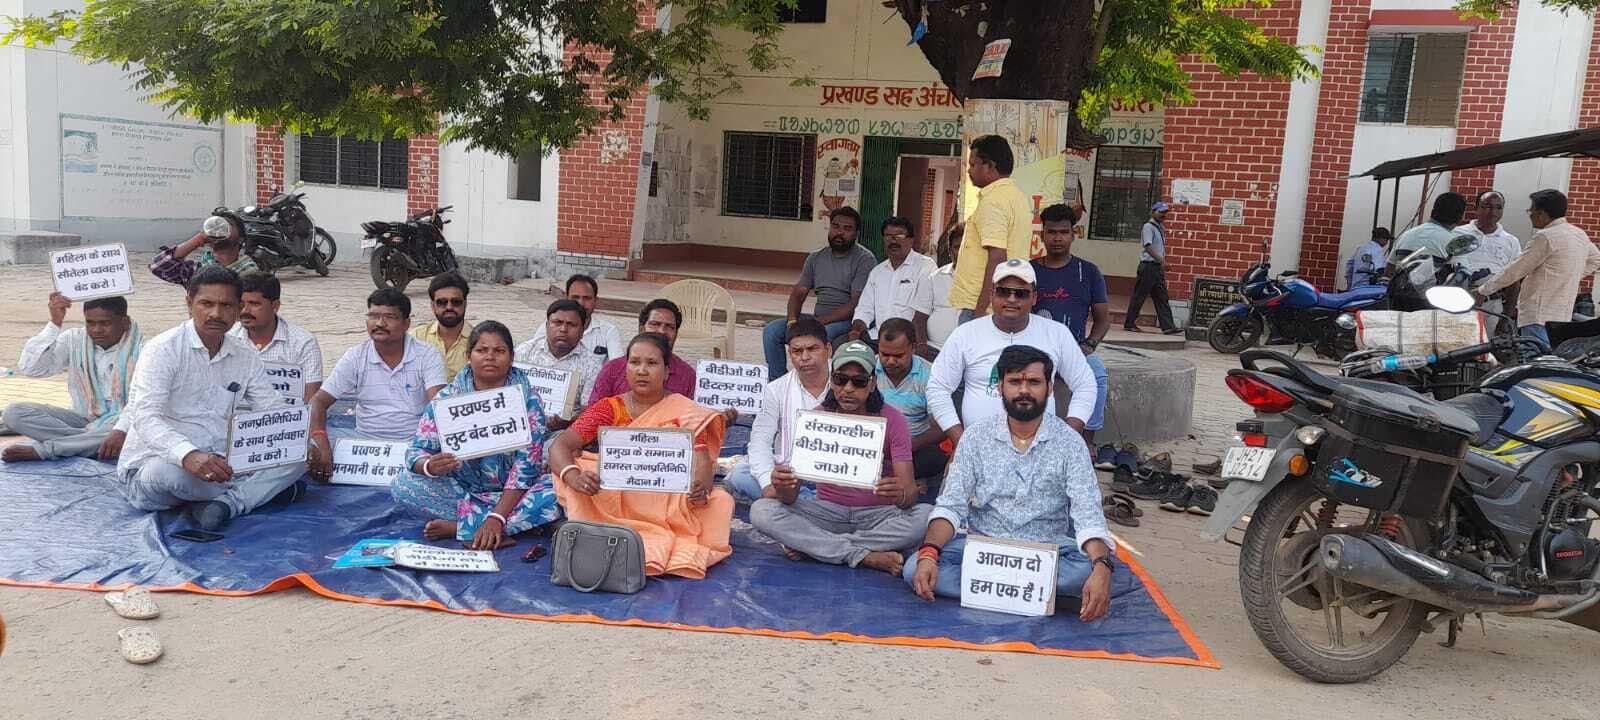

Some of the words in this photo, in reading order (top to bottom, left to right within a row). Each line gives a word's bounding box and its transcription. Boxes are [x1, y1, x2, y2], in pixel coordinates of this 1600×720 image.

[820, 84, 880, 106] प्रखण्ड
[883, 86, 918, 107] सह
[56, 252, 87, 263] महिला
[89, 249, 99, 260] के
[101, 248, 121, 257] साथ
[90, 263, 124, 274] व्यवहार
[90, 279, 109, 289] करो
[705, 363, 743, 376] बीडीओ
[745, 366, 760, 378] की
[699, 378, 736, 390] हिटलर
[737, 382, 763, 394] शाही
[448, 399, 491, 421] प्रखण्ड
[494, 392, 506, 409] में
[721, 397, 755, 408] चलेगी
[469, 424, 489, 440] बंद
[491, 417, 518, 436] करो
[805, 418, 875, 439] संस्कारहीन
[234, 436, 245, 448] के
[246, 436, 266, 446] साथ
[629, 432, 659, 443] महिला
[352, 445, 381, 456] प्रखण्ड
[383, 444, 392, 457] में
[606, 447, 630, 459] प्रमुख
[632, 446, 642, 456] के
[644, 449, 675, 458] सम्मान
[676, 448, 685, 458] में
[795, 435, 840, 454] बीडीओ
[841, 445, 877, 460] वापस
[247, 452, 262, 463] बंद
[263, 448, 281, 460] करो
[371, 463, 385, 475] बंद
[603, 462, 632, 471] समस्त
[814, 460, 849, 474] जाओ
[976, 551, 1024, 569] आवाज
[1026, 554, 1042, 572] दो
[970, 578, 994, 595] हम
[996, 582, 1021, 598] एक
